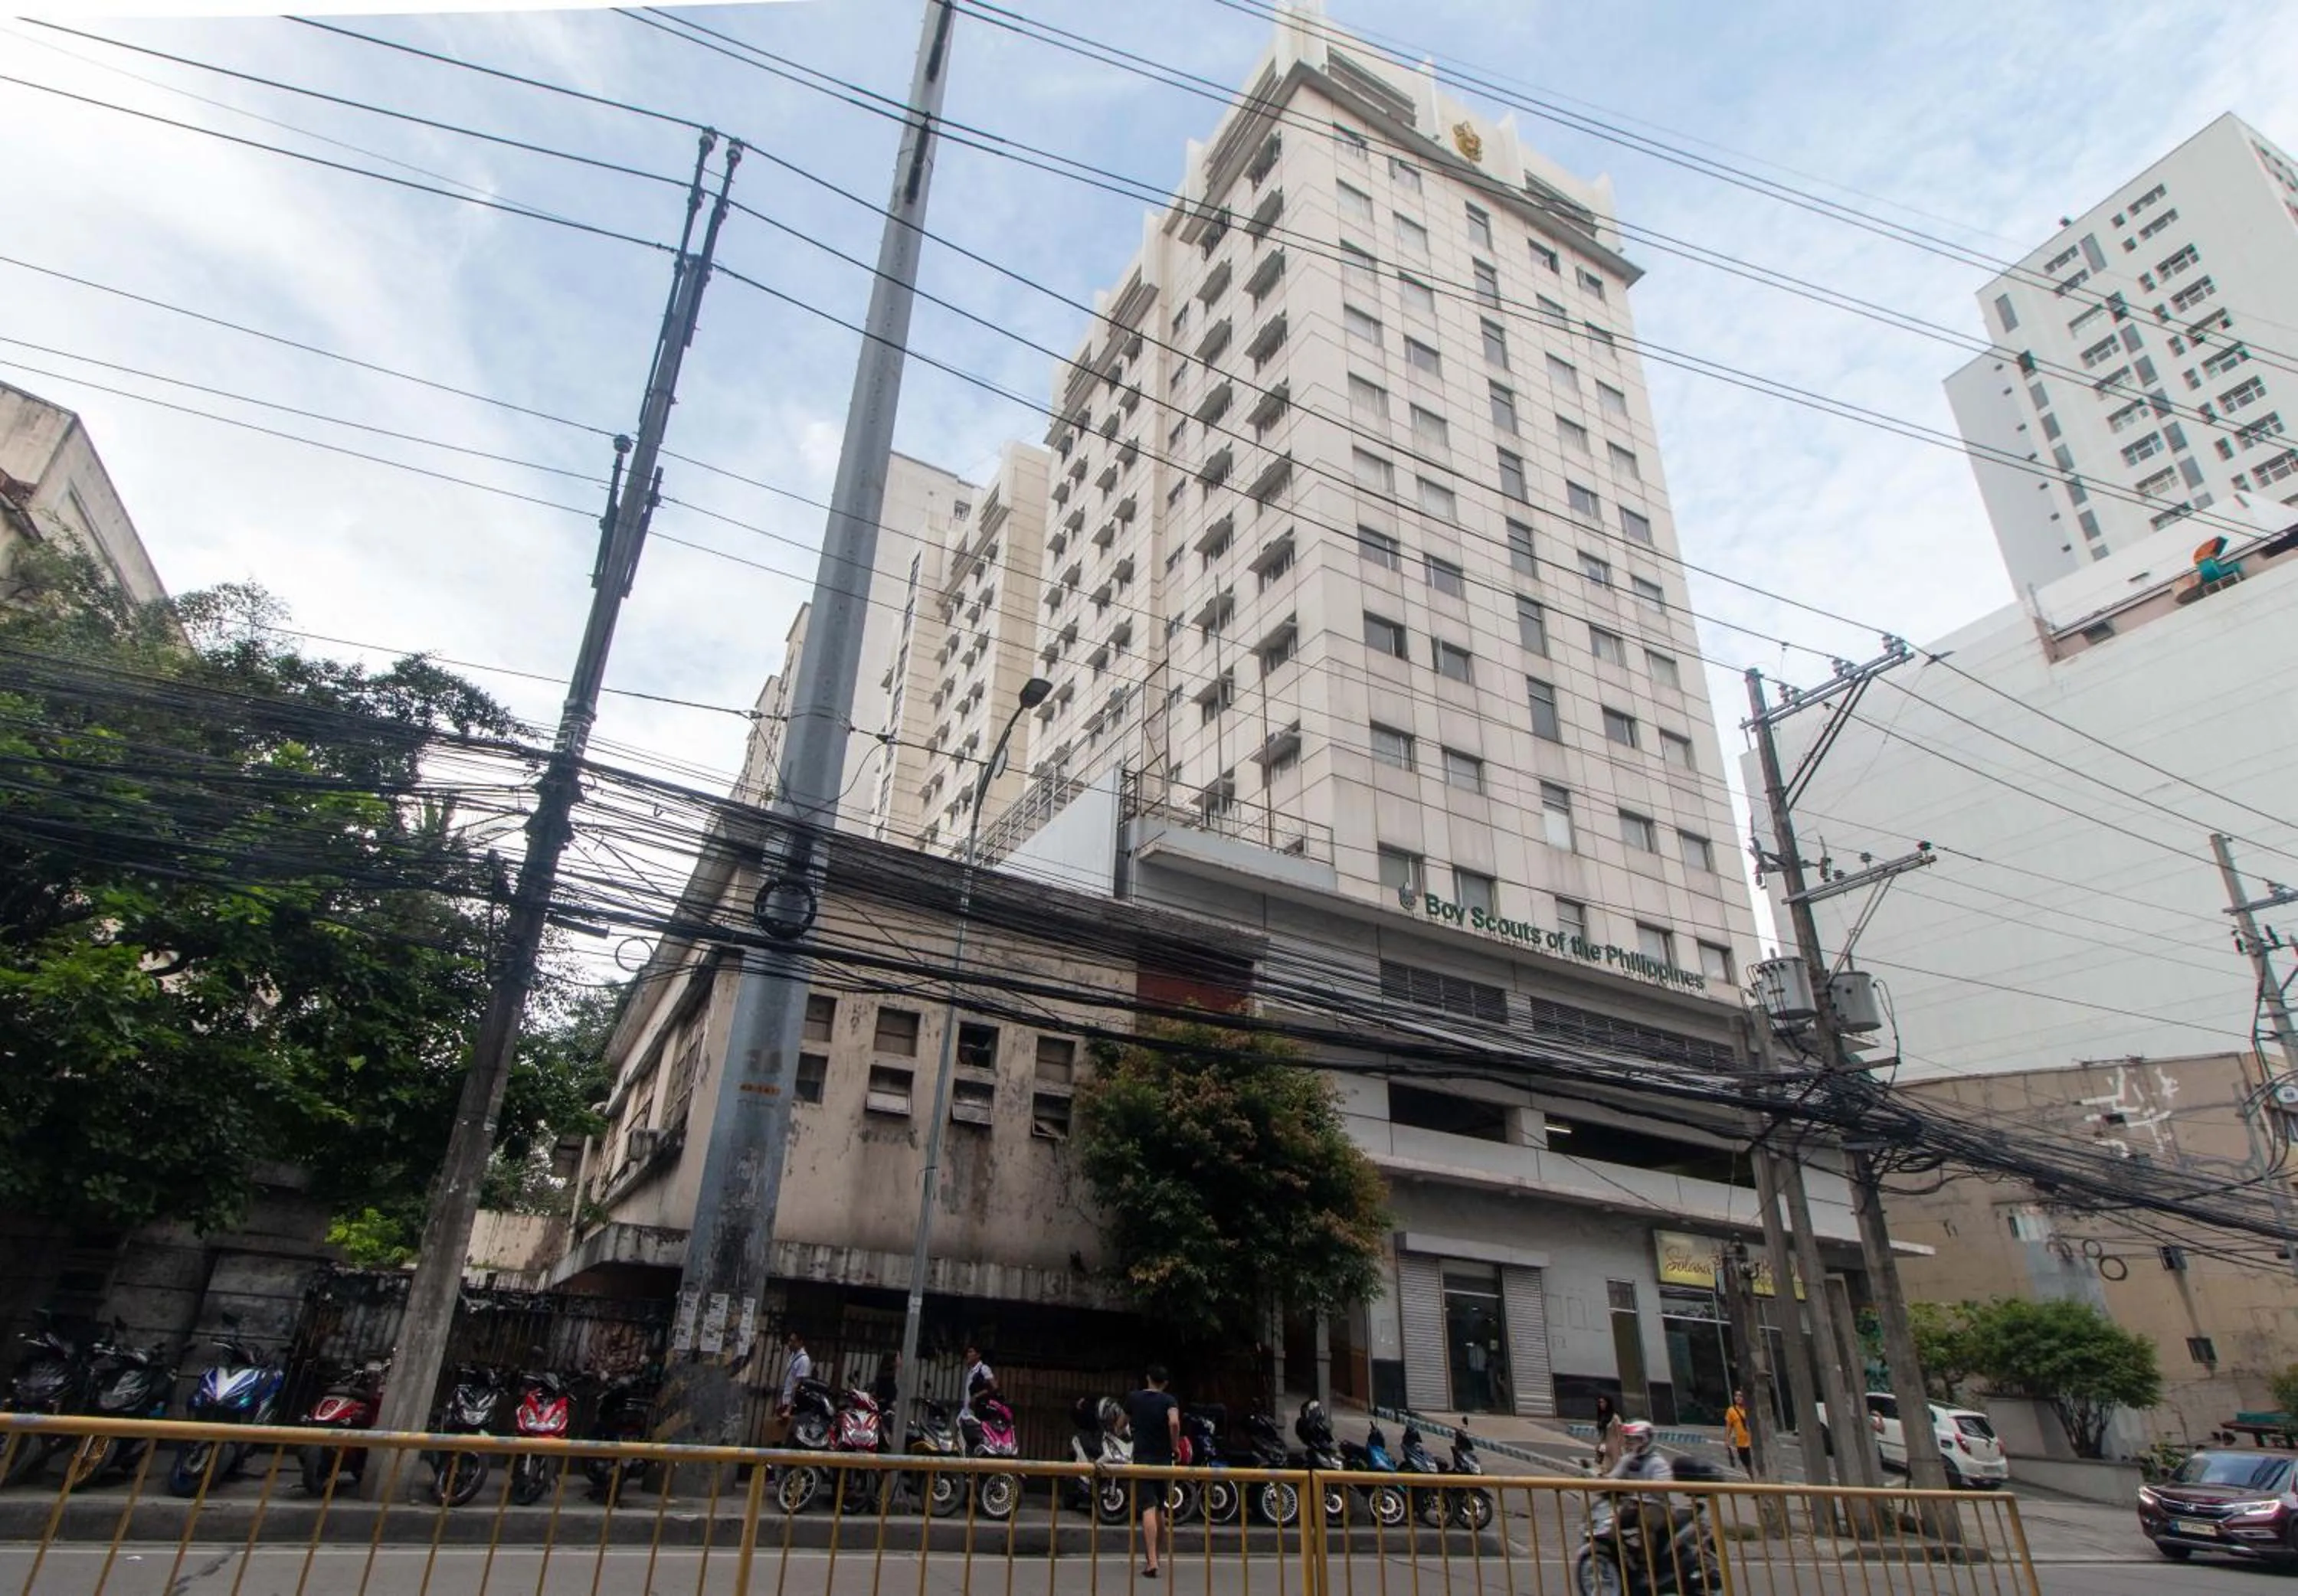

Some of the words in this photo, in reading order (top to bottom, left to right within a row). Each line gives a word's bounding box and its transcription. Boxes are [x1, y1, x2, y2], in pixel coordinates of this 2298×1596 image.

[1424, 892, 1465, 925] Boy
[1470, 907, 1542, 944] Scouts
[1546, 931, 1566, 952] of
[1571, 936, 1602, 961] the
[1606, 944, 1706, 989] Philippines
